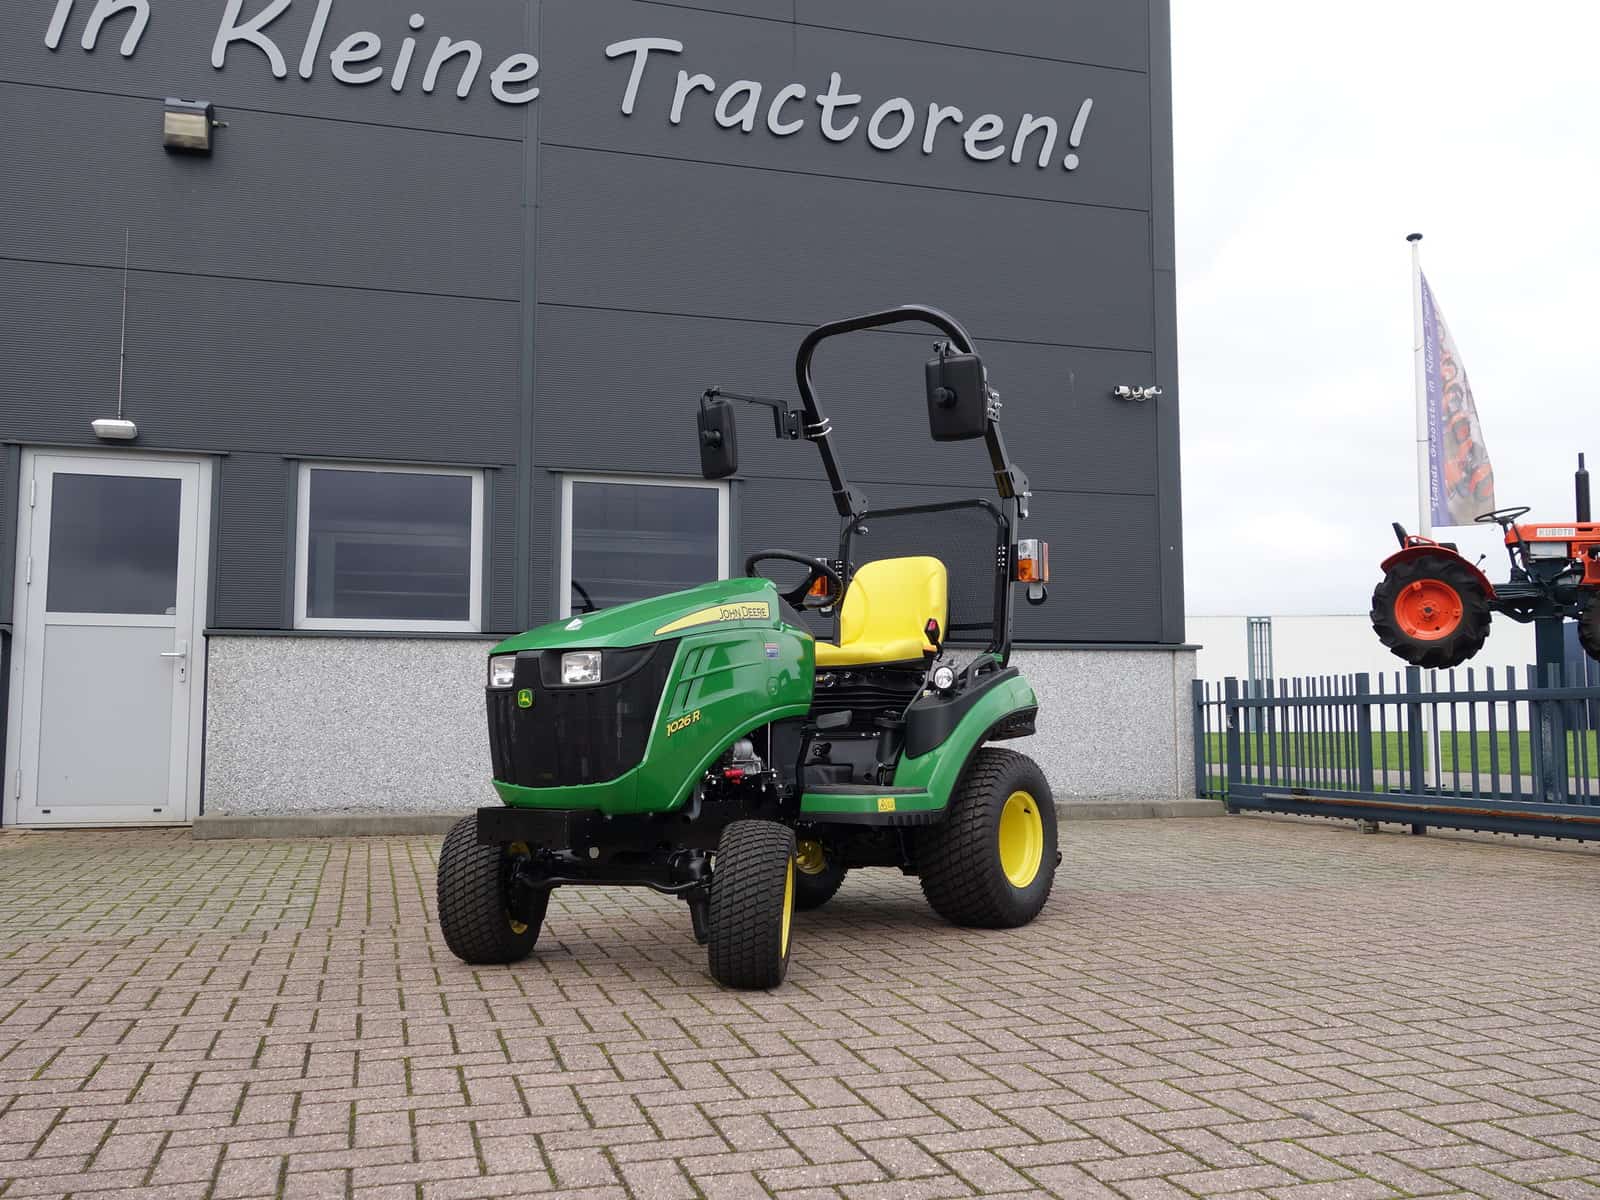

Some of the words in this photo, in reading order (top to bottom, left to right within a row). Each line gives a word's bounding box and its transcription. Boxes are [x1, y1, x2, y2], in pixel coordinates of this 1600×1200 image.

[210, 0, 540, 104] Kleine
[605, 37, 1093, 171] Tractoren!
[719, 607, 741, 620] JOHN
[741, 605, 767, 617] DEERE
